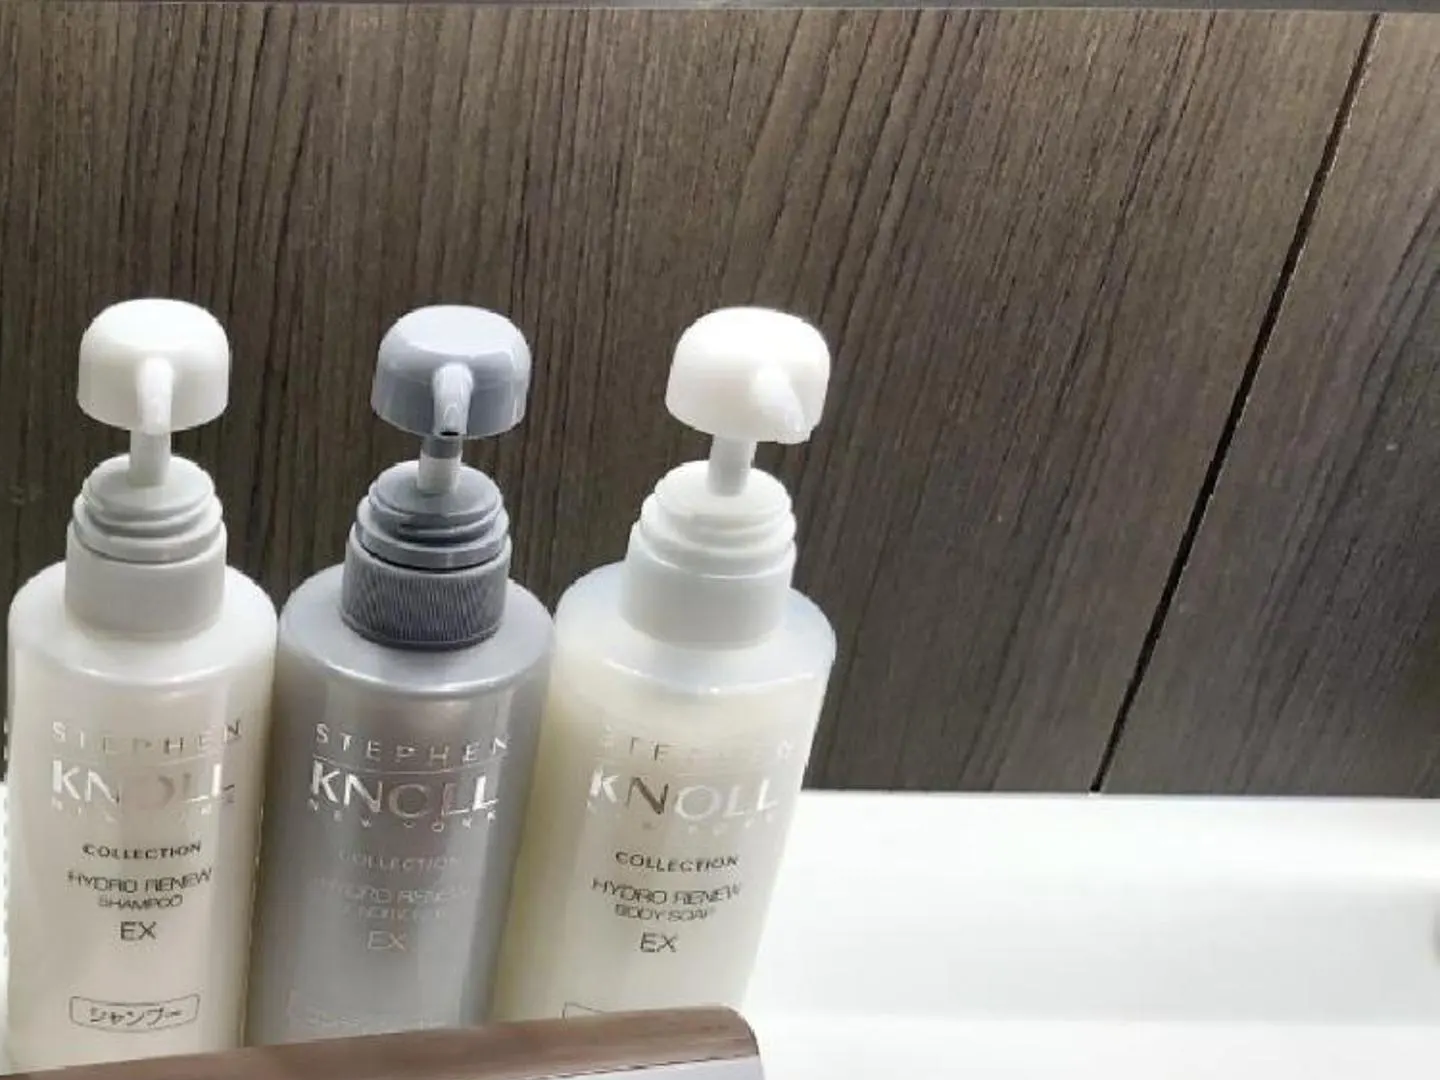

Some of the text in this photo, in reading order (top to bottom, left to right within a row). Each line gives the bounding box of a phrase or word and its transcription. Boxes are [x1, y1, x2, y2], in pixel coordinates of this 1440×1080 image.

[315, 723, 509, 764] STEPHEN
[312, 760, 500, 819] KNOLL
[588, 765, 779, 820] KNOLL
[82, 841, 202, 860] COLLECTION
[615, 851, 739, 873] COLLECTION
[67, 866, 213, 893] HYDRO RENEW
[592, 878, 742, 905] HYDRO RENEW
[98, 894, 184, 912] SHAMPOO
[615, 902, 666, 922] BODY
[120, 921, 158, 942] EX
[367, 930, 407, 952] EX
[640, 931, 678, 953] EX
[89, 1006, 186, 1027] シャンプー
